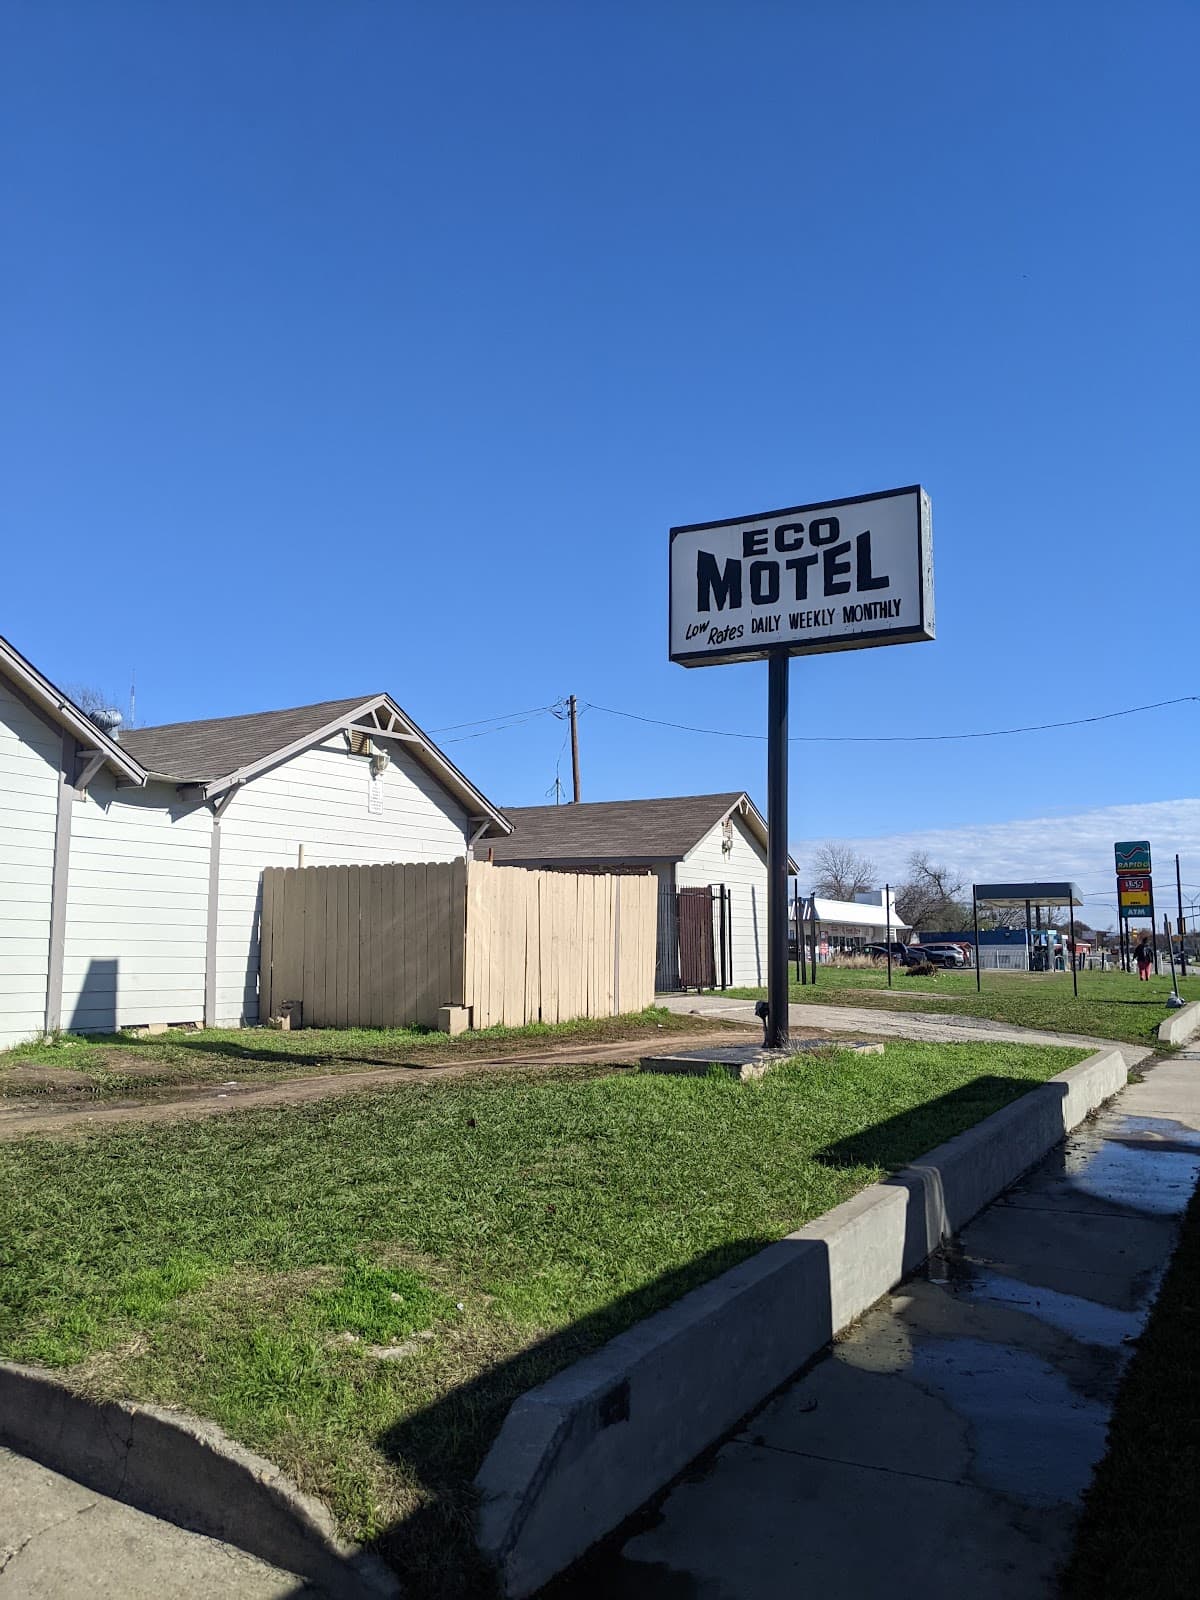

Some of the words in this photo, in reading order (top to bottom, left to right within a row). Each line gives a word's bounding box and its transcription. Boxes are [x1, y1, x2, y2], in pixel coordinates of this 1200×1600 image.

[743, 517, 839, 557] ECO
[697, 530, 890, 613] MOTEL
[685, 620, 710, 641] Low
[707, 623, 744, 645] Rates
[751, 614, 781, 634] DAILY
[789, 608, 836, 630] WEEKLY
[843, 598, 902, 623] MONTHLY
[1128, 908, 1145, 916] ATM
